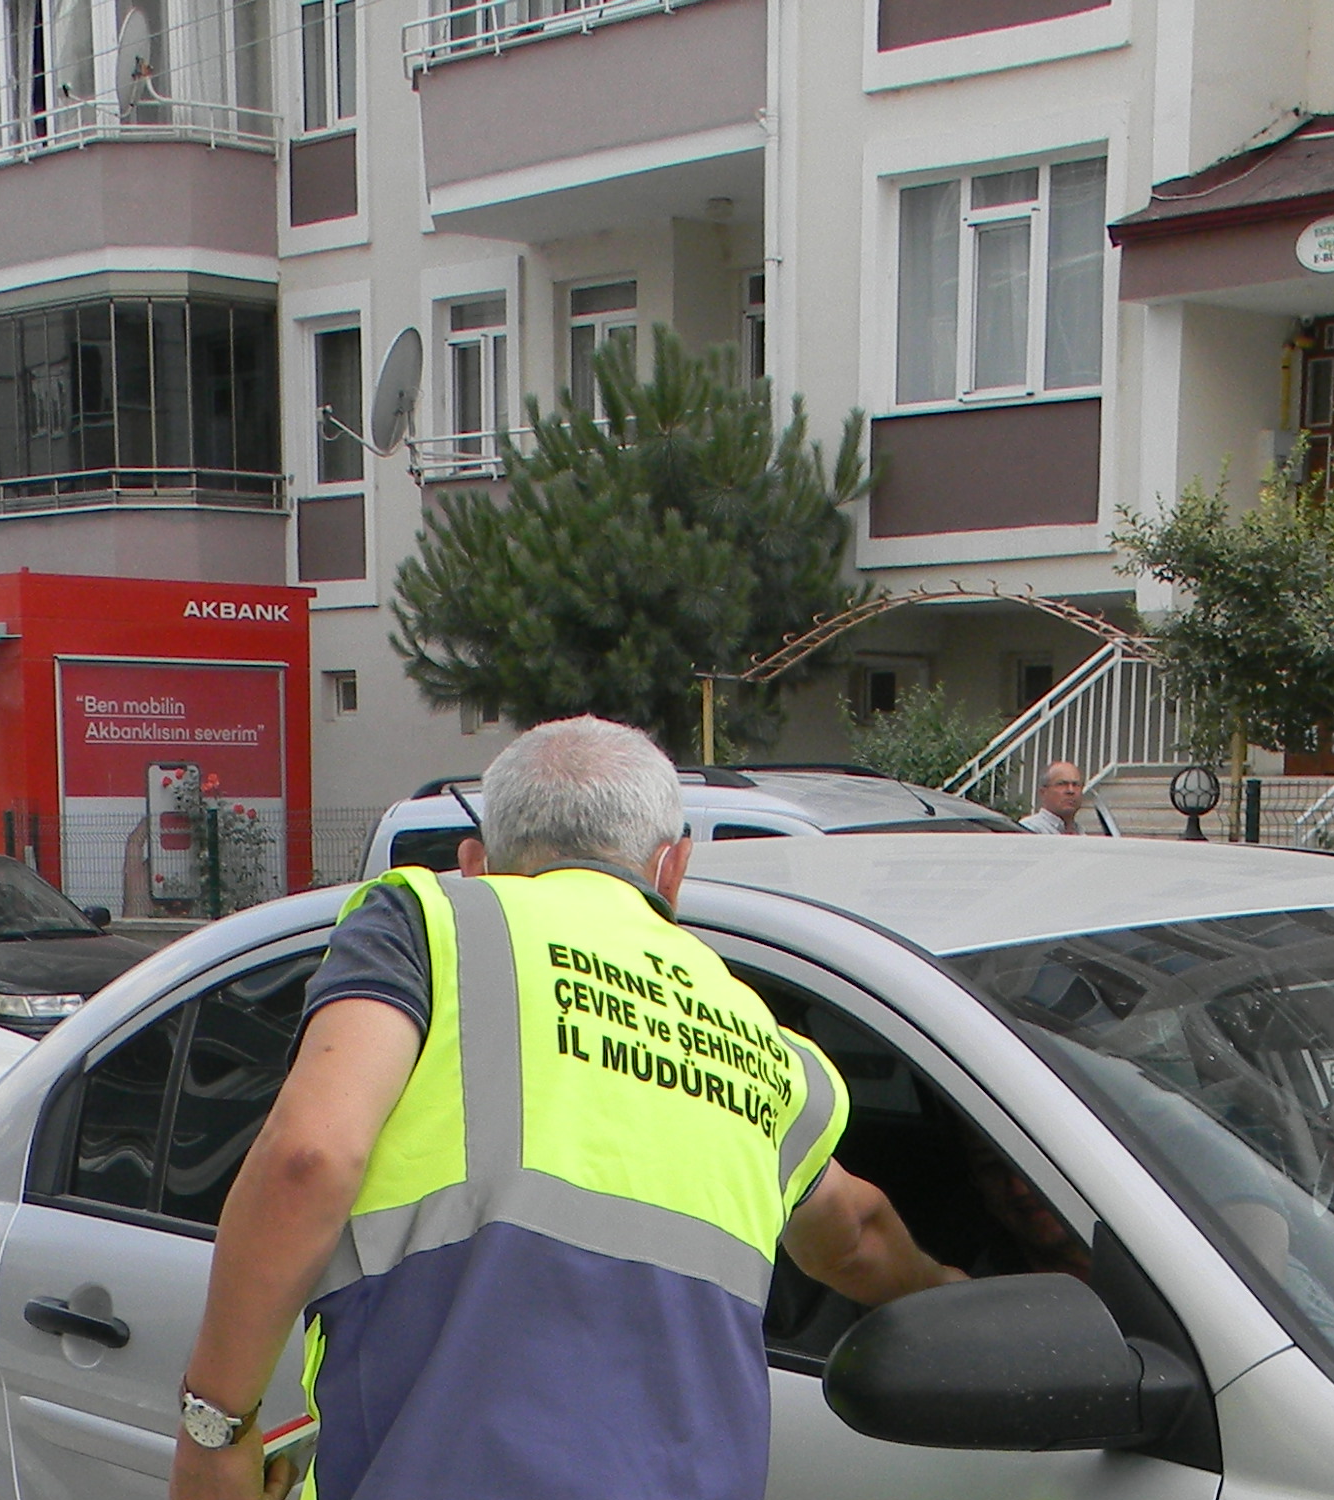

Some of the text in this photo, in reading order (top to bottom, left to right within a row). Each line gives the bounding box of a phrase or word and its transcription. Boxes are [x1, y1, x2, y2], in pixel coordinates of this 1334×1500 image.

[183, 601, 290, 622] AKBANK
[123, 697, 185, 715] mobilin
[547, 943, 667, 1008] EDİRNE
[554, 978, 639, 1031] ÇEVRE
[644, 1015, 671, 1043] ve
[557, 1016, 590, 1063] İL
